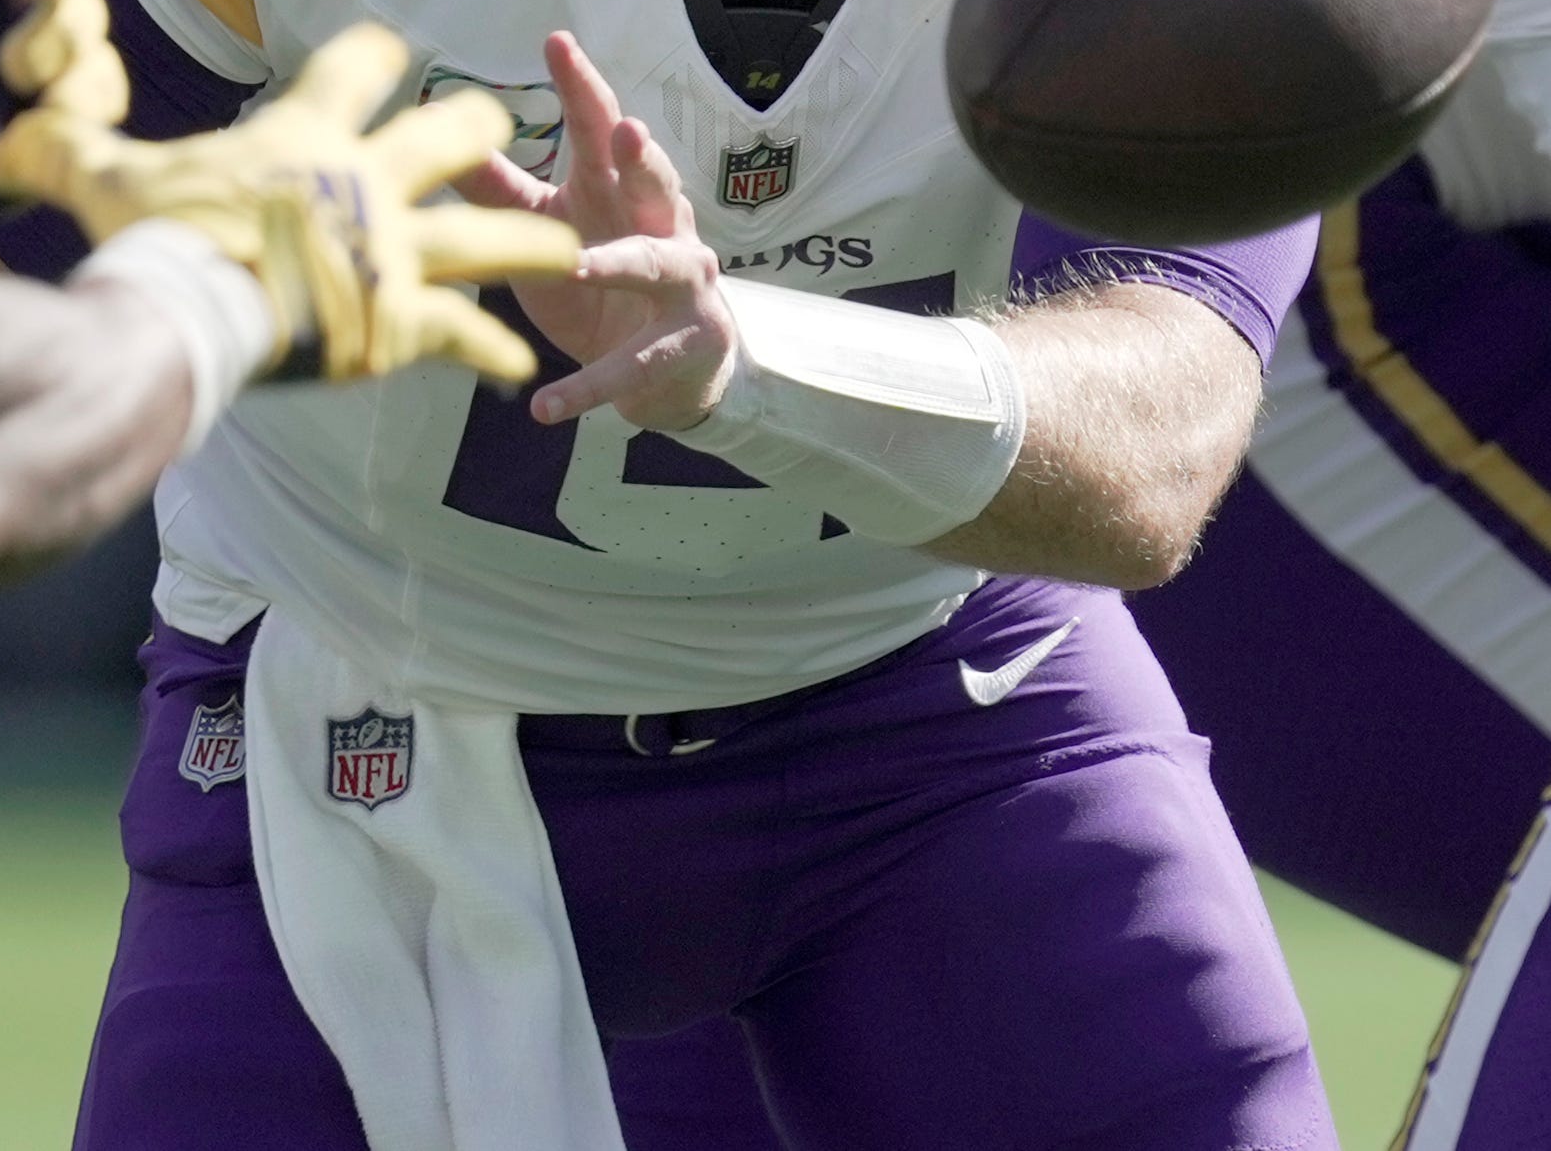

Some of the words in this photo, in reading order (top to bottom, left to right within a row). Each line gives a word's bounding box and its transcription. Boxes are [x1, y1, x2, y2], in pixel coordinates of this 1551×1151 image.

[747, 71, 781, 89] 14
[730, 170, 783, 200] NFL
[191, 738, 240, 771] NFL
[337, 753, 403, 798] NFL
